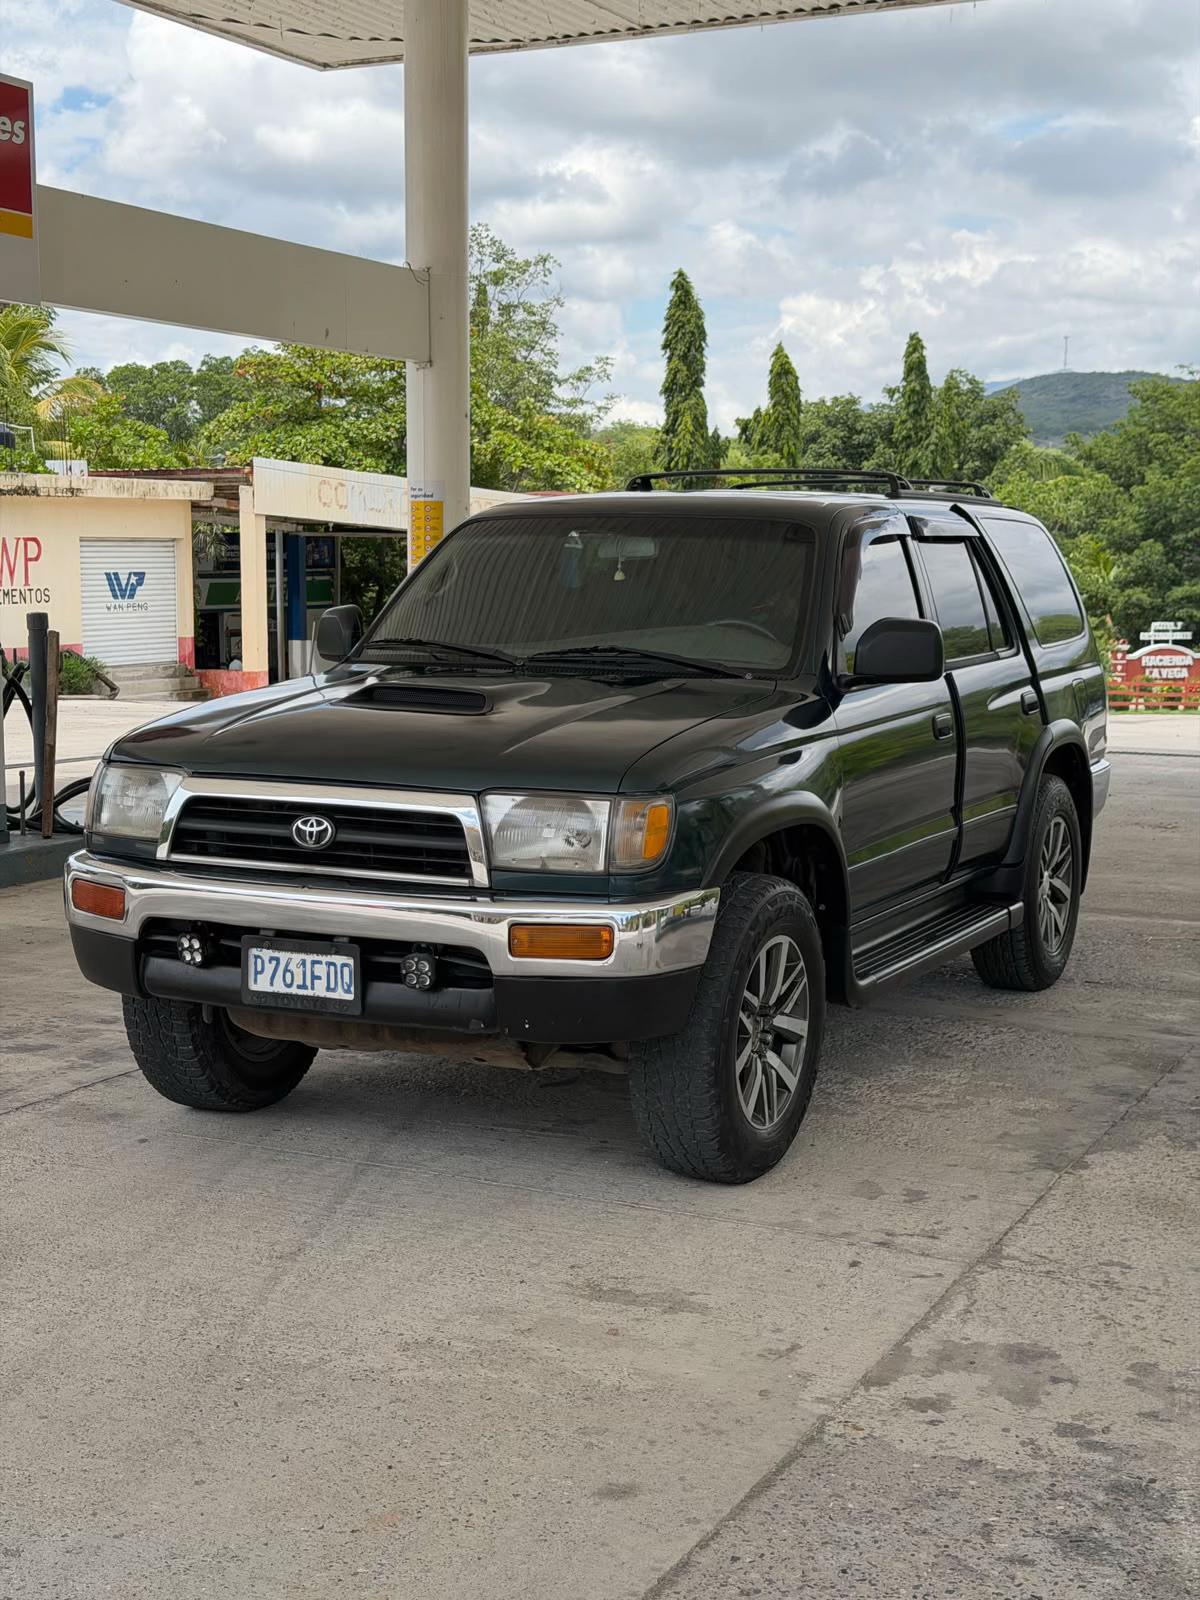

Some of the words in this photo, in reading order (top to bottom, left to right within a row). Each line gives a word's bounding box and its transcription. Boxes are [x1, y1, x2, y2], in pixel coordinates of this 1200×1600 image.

[0, 588, 51, 605] MENTOS
[106, 604, 124, 612] WAN
[126, 602, 149, 611] PENG
[253, 954, 353, 994] P761FDQ
